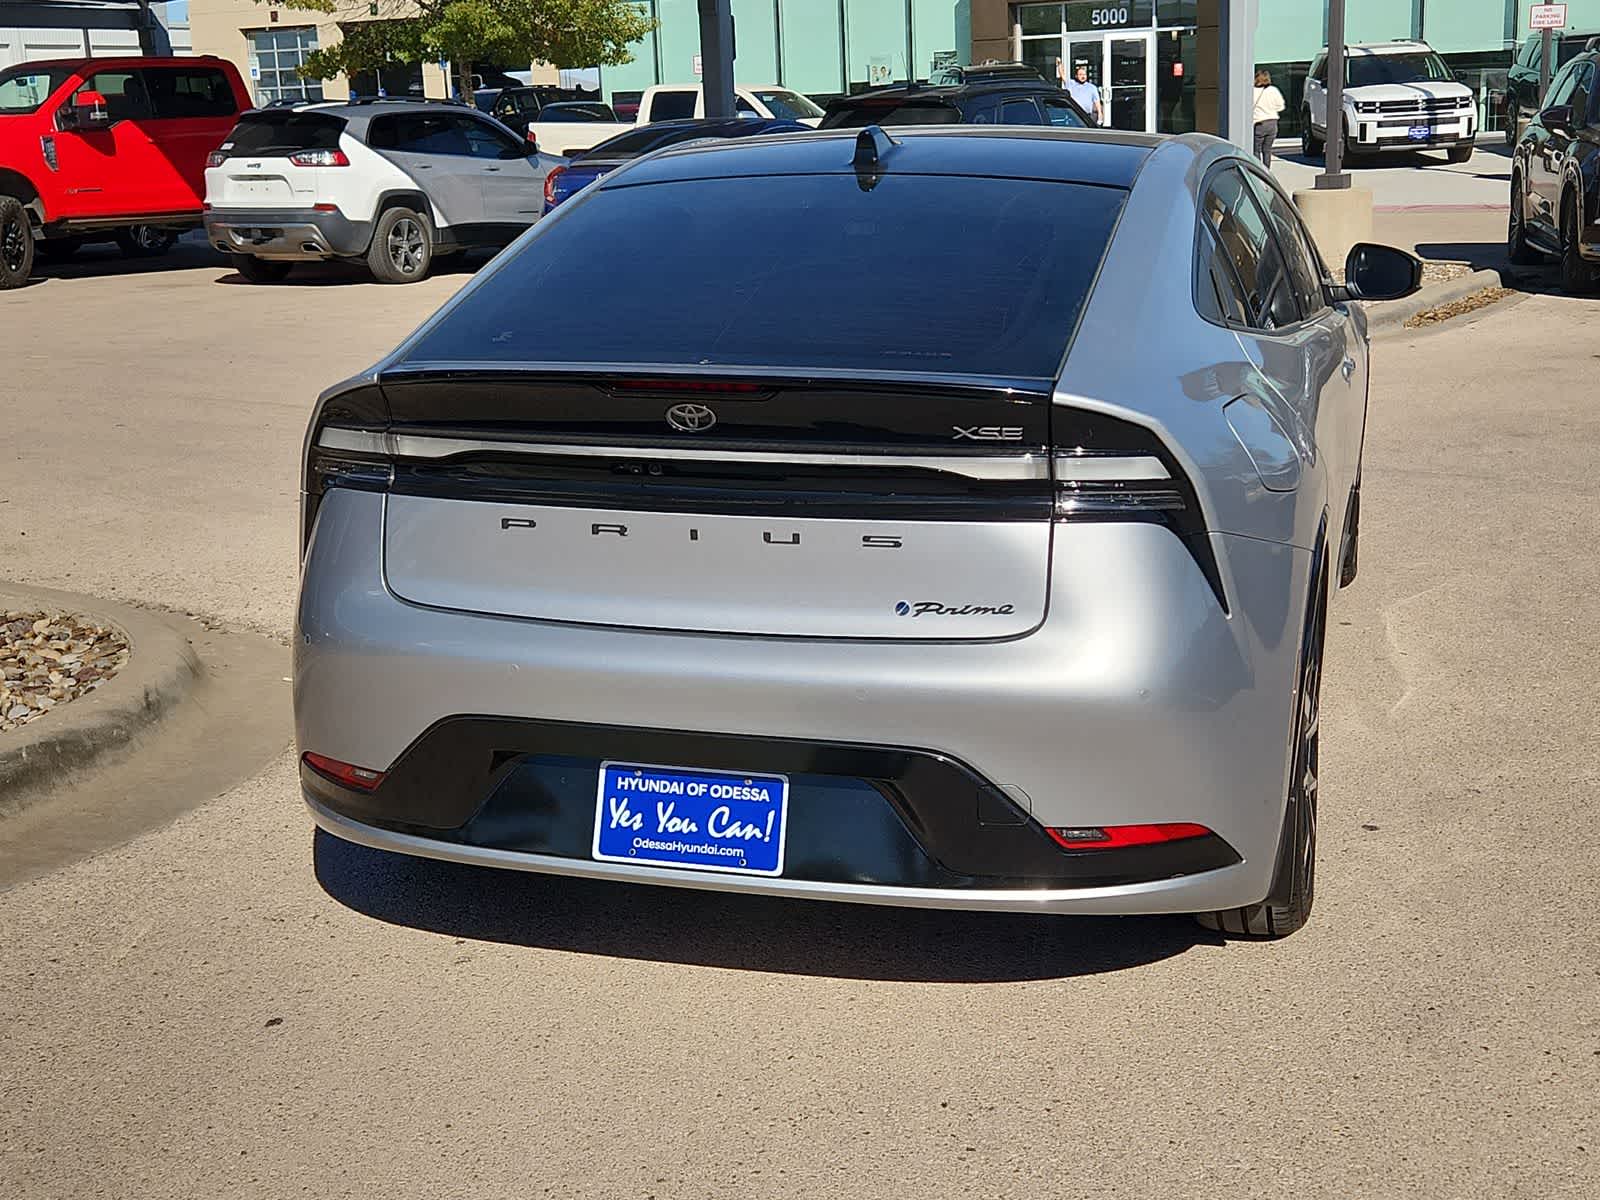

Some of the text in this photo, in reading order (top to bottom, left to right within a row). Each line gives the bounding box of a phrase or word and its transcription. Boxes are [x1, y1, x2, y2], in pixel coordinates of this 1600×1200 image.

[1091, 8, 1127, 25] 5000
[952, 426, 1023, 440] XSE
[501, 518, 902, 549] PRIUS
[912, 602, 1015, 617] Prime
[617, 776, 770, 802] HYUNDAI OF ODESSA
[609, 798, 776, 842] Yes You Can!
[633, 837, 744, 858] OdessaHyundai.com
